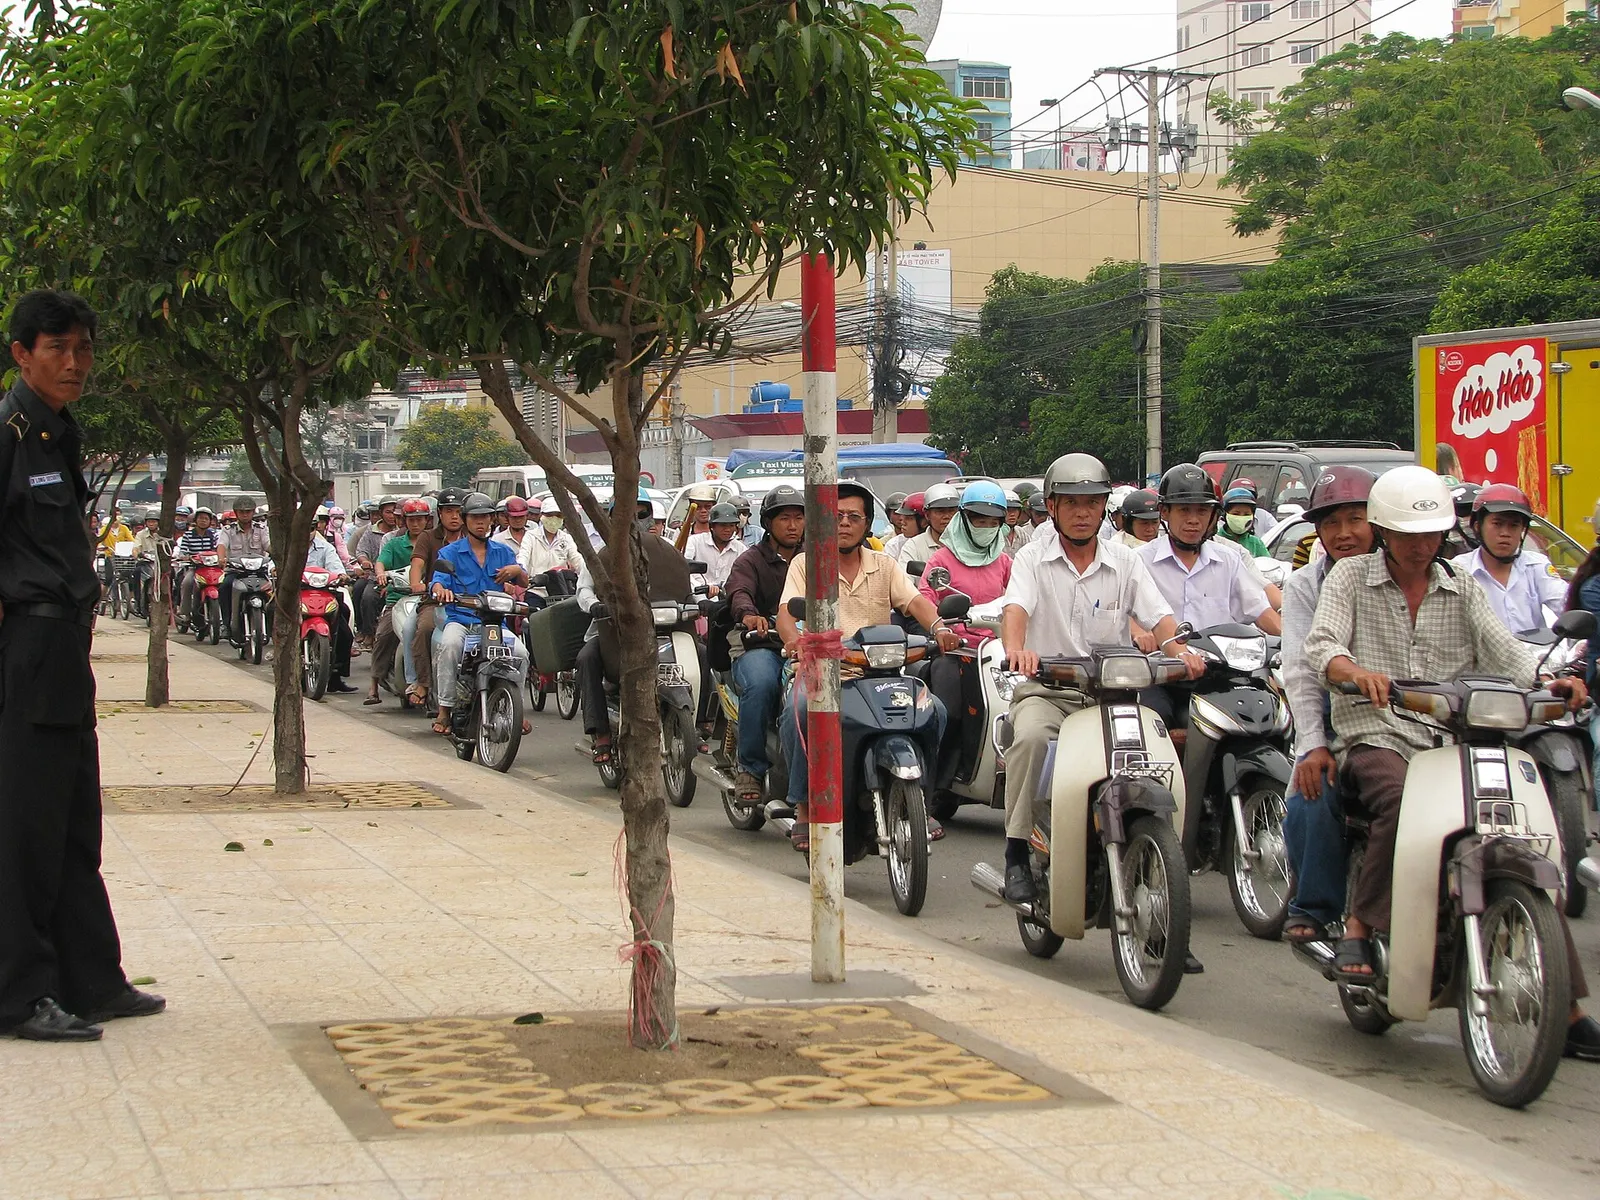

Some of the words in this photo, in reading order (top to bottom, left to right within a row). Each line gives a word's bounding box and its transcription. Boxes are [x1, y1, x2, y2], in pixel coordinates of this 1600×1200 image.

[915, 258, 940, 266] TOWER
[1459, 375, 1494, 426] Hảo
[1497, 358, 1534, 410] Hảo
